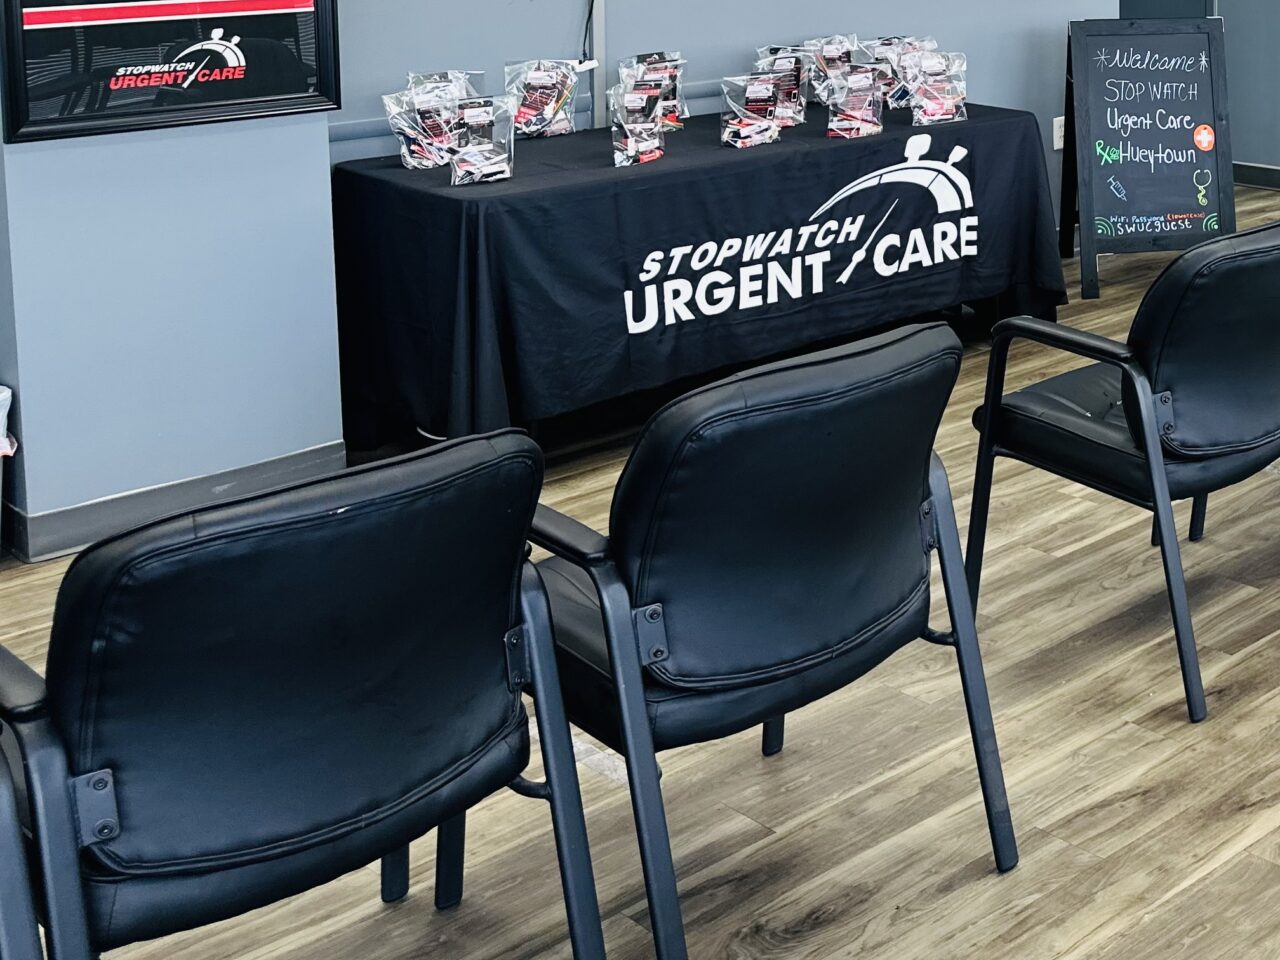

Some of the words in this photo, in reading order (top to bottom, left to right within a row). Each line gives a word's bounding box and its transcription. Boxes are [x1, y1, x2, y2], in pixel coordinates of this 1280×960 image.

[109, 72, 187, 90] URGENT
[197, 66, 246, 82] CARE
[116, 62, 196, 75] STOPWATCH
[1104, 79, 1145, 103] STOP
[1148, 81, 1198, 102] WATCH
[1107, 107, 1153, 137] Urgent
[1155, 108, 1195, 130] Care
[1119, 141, 1196, 173] Hueytown
[639, 214, 865, 282] STOPWATCH
[624, 250, 831, 334] URGENT
[873, 215, 979, 276] CARE
